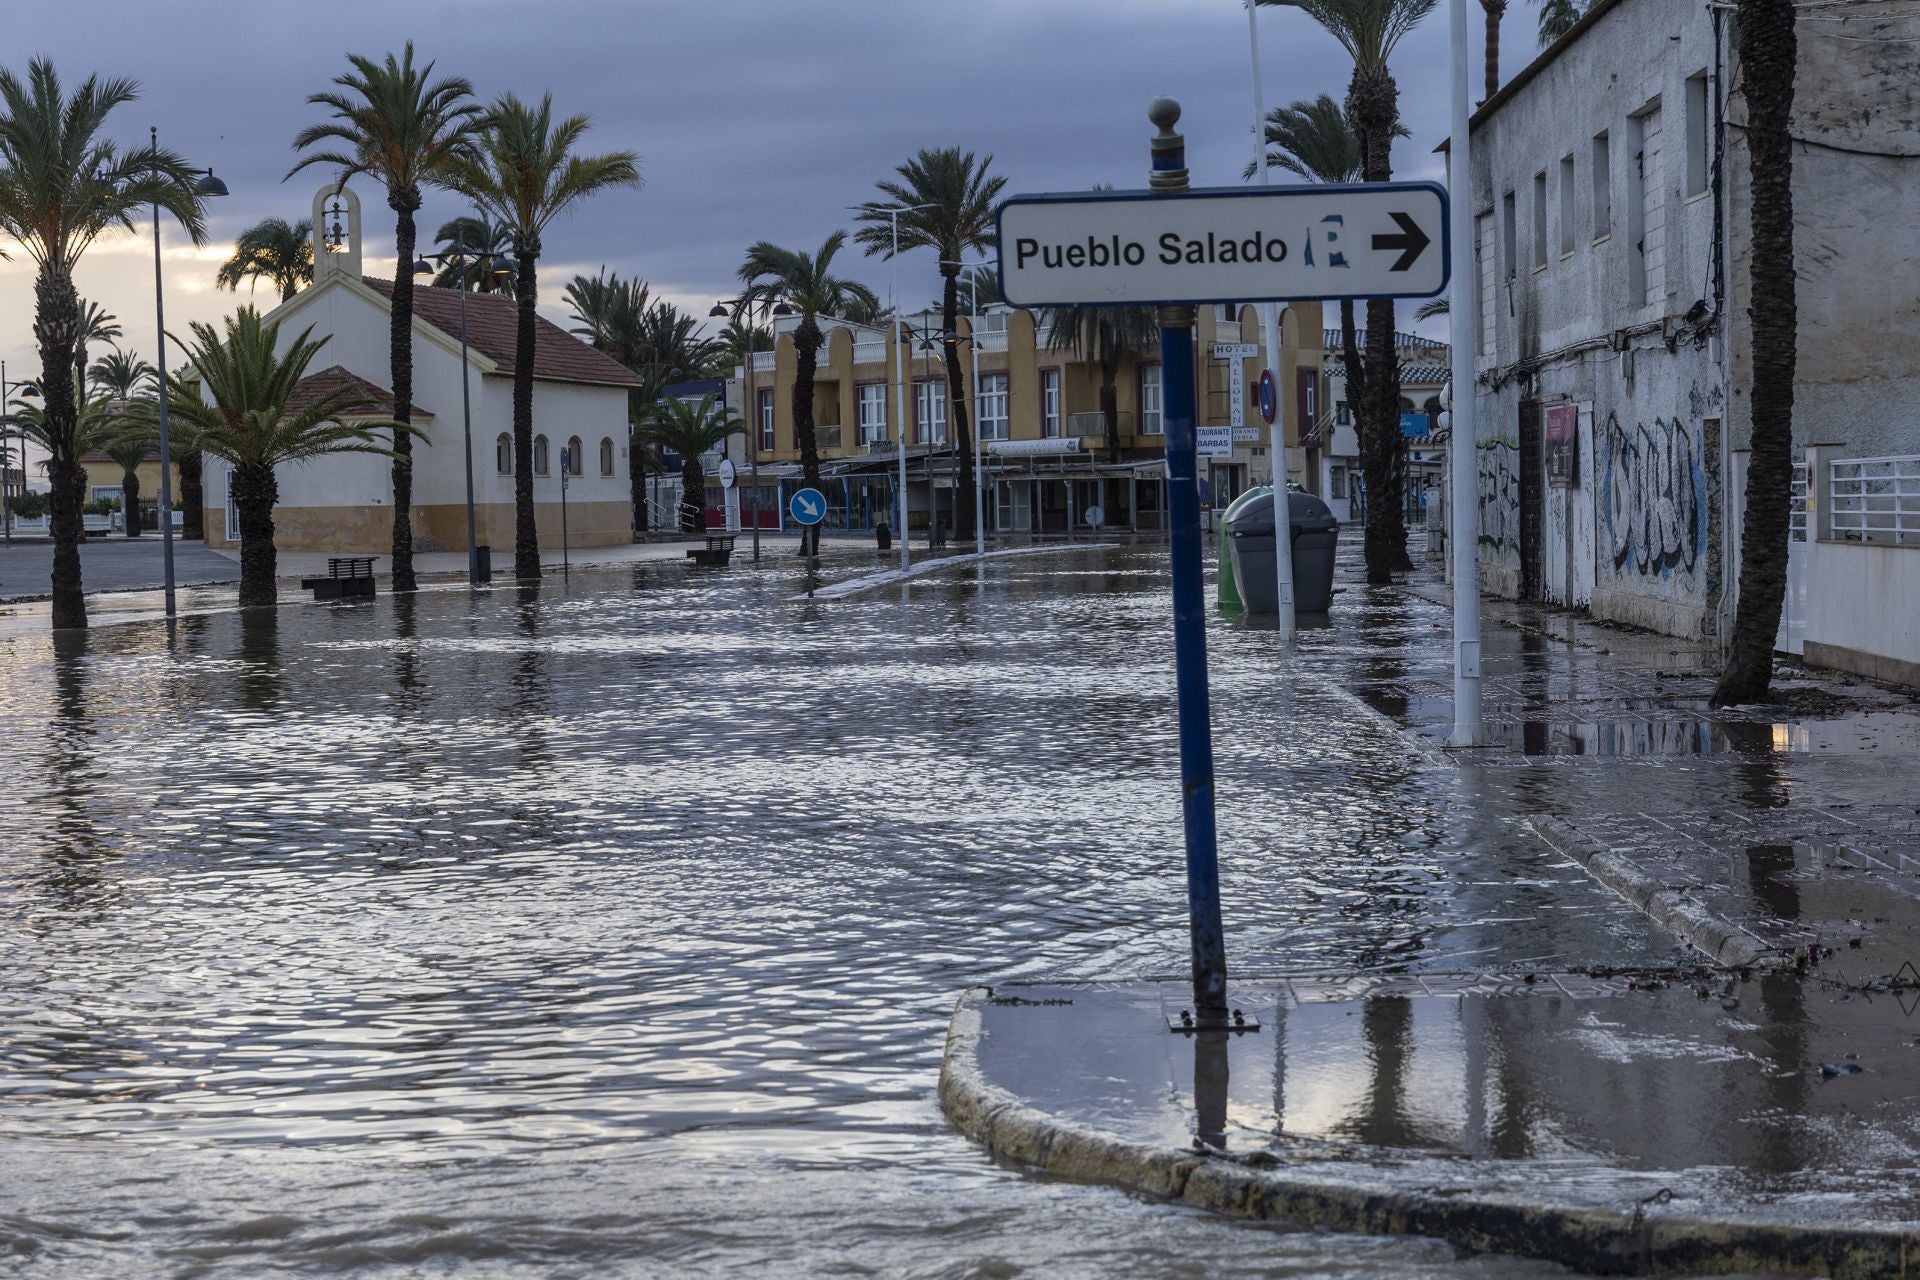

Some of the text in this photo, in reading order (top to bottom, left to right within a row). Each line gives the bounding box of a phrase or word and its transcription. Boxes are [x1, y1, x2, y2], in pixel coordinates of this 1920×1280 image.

[1016, 234, 1145, 270] Pueblo
[1158, 230, 1288, 266] Salado
[1216, 345, 1256, 353] HOTEL
[1197, 428, 1230, 436] TAURANTE
